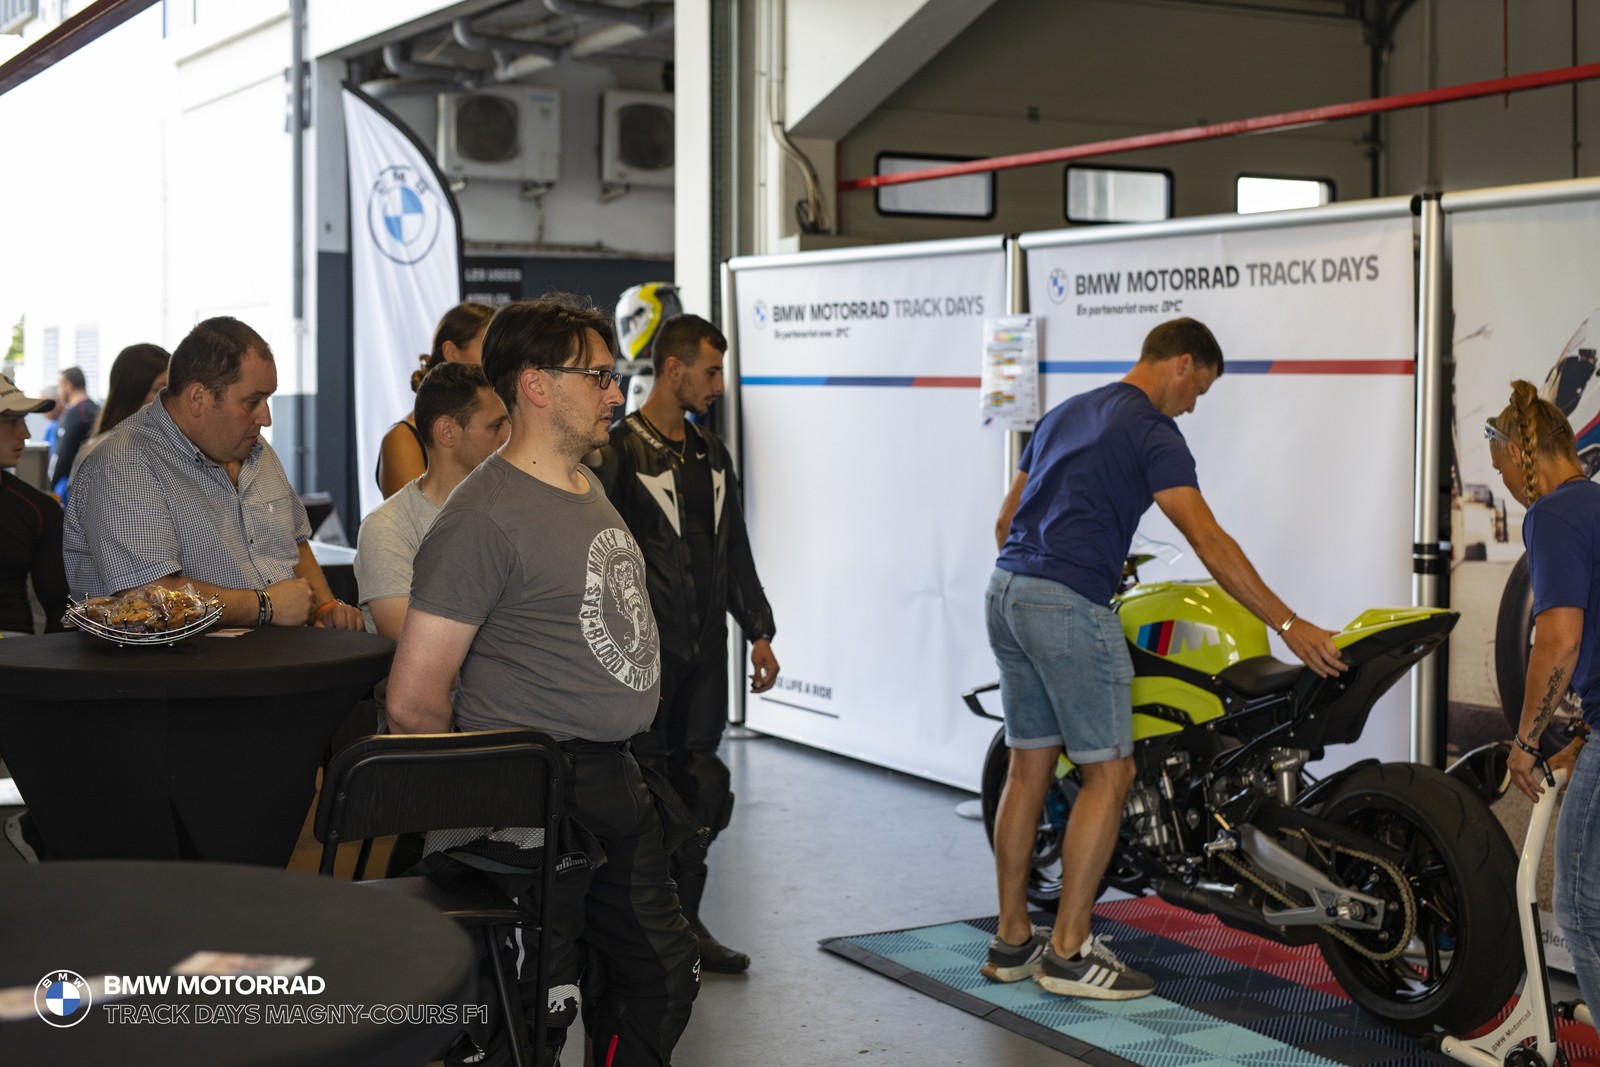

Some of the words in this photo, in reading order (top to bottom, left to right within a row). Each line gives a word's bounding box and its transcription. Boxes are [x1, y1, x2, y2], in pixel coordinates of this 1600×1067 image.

[1075, 272, 1121, 295] BMW
[1127, 265, 1240, 293] MOTORRAD
[1246, 259, 1317, 287] TRACK
[1322, 254, 1380, 283] DAYS
[773, 304, 806, 323] BMW
[809, 301, 890, 322] MOTORRAD
[894, 298, 943, 318] TRACK
[944, 295, 985, 317] DAYS
[1076, 304, 1087, 316] En
[1089, 301, 1138, 318] partenariat
[1138, 304, 1159, 314] avec
[588, 529, 619, 577] MONKEY
[580, 585, 601, 620] GAS
[585, 628, 627, 675] BLOOD
[624, 665, 655, 689] SWEAT
[1491, 1034, 1507, 1052] BMW
[1505, 1009, 1532, 1038] Motorrad
